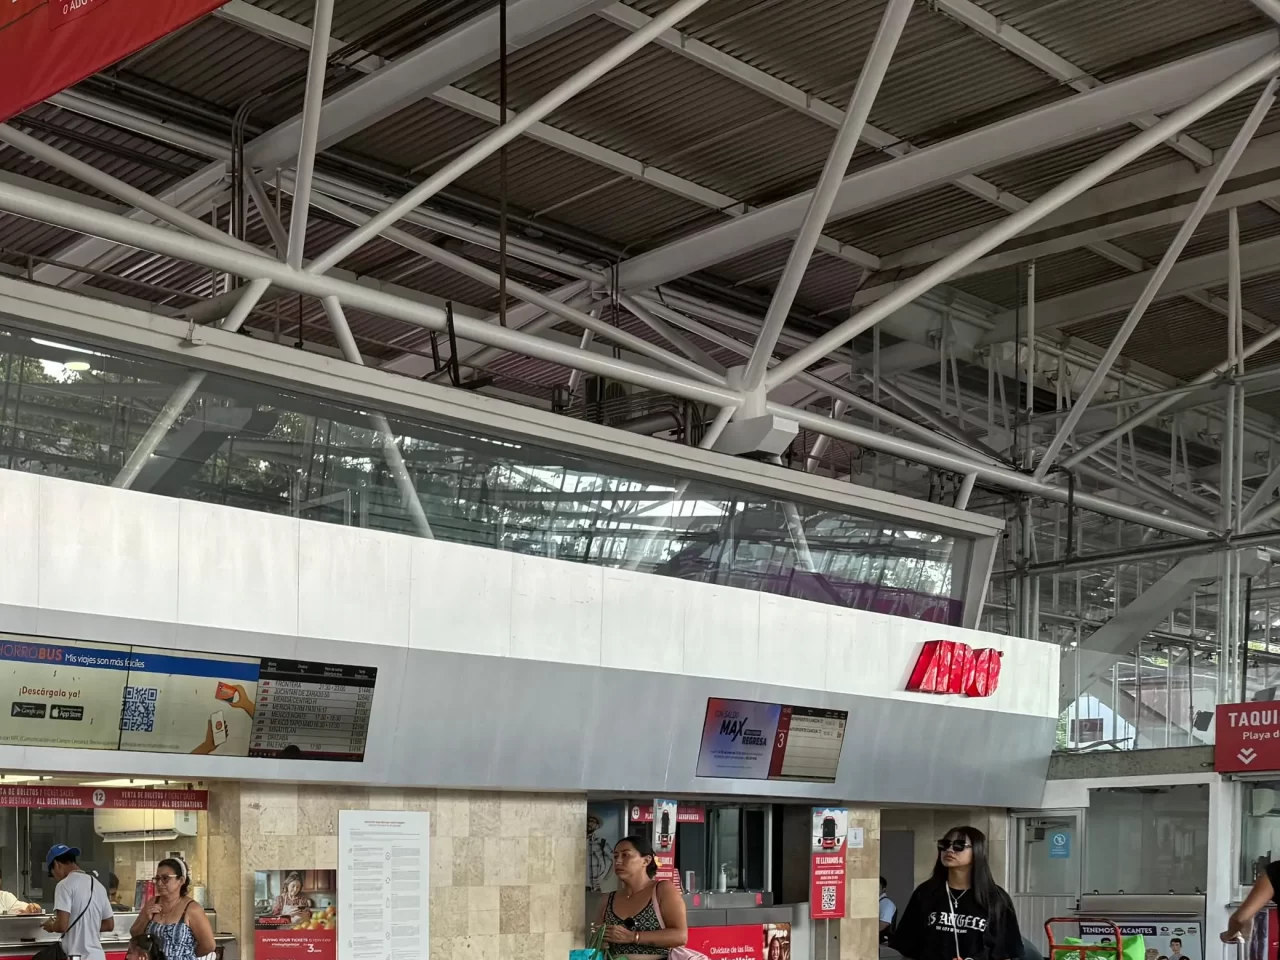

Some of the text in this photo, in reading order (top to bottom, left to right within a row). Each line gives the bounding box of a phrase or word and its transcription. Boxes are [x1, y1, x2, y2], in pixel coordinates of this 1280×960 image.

[65, 653, 77, 662] Mis
[1228, 710, 1280, 727] TAQUI
[720, 717, 748, 742] MAX
[1243, 731, 1270, 740] Playa
[95, 792, 103, 801] 12
[307, 944, 314, 952] 3
